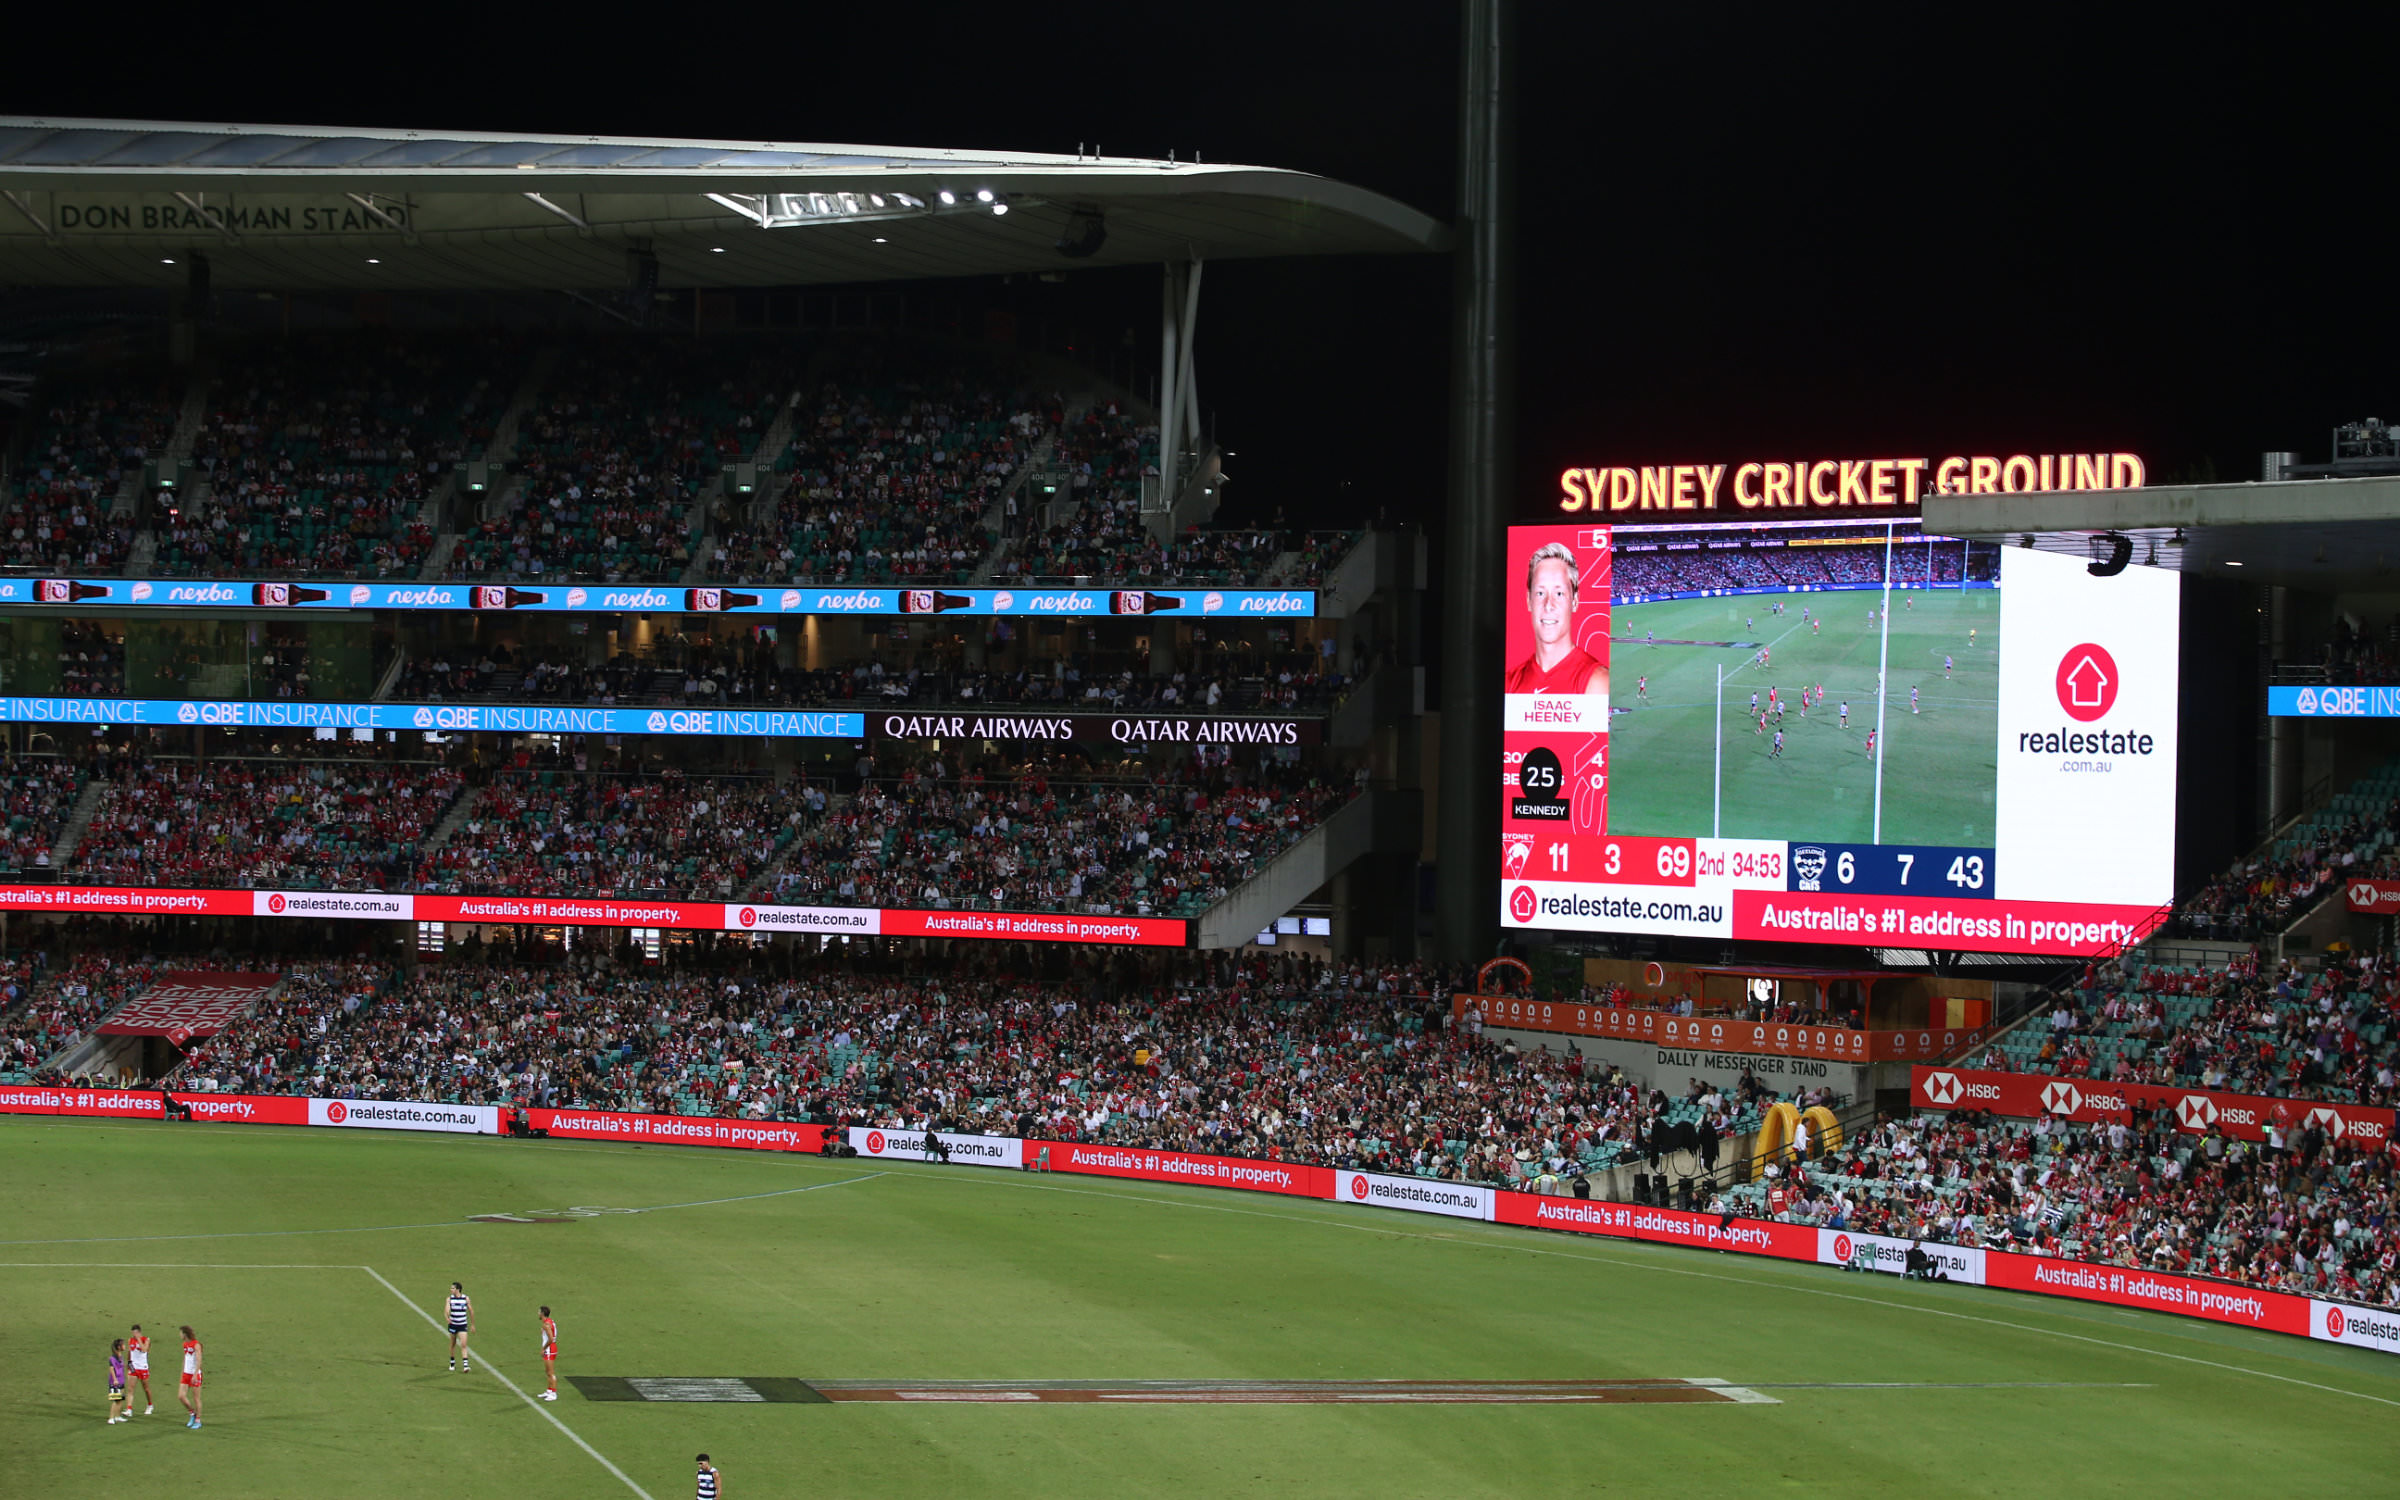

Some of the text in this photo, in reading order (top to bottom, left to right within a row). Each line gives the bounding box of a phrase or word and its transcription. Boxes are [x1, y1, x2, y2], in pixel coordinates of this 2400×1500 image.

[60, 204, 406, 232] DON BRADMAN STAND
[1560, 452, 2145, 512] SYDNEY CRICKET GROUND
[1592, 529, 1608, 549] 5
[12, 700, 147, 722] INSURANCE
[1534, 700, 1572, 711] ISAAC
[2321, 687, 2366, 715] QBE
[201, 703, 383, 727] QBE INSURANCE
[436, 708, 617, 731] QBE INSURANCE
[670, 711, 849, 736] QBE INSURANCE
[1524, 711, 1582, 723] HEENEY
[885, 716, 1073, 740] QATAR AIRWAYS
[1111, 719, 1297, 744] QATAR AIRWAYS
[2020, 727, 2153, 755] realestate
[1591, 752, 1604, 768] 4
[2059, 761, 2112, 773] .com.au
[1527, 766, 1555, 787] 25
[1590, 774, 1604, 789] 0
[1515, 804, 1566, 816] KENNEDY
[1502, 832, 1535, 840] SYDNEY
[1549, 843, 1569, 872] 11
[1604, 843, 1621, 875] 3
[1657, 845, 1690, 878] 69
[1698, 851, 1781, 879] 2nd 34:53
[1837, 851, 1855, 884] 6
[1897, 854, 1914, 886] 7
[1946, 855, 1984, 890] 43
[1799, 879, 1821, 892] CATS
[2380, 890, 2400, 902] HSB
[55, 891, 71, 904] #1
[73, 891, 128, 906] address
[131, 893, 143, 906] in
[146, 895, 208, 911] property.
[288, 896, 399, 914] realestate.com.au
[459, 901, 681, 923] Australia’s #1 address in property.
[1542, 893, 1723, 923] realestate.com.au
[758, 911, 868, 928] realestate.com.au
[925, 915, 1140, 939] Australia’s #1 address in property.
[1761, 903, 2140, 948] Australia's #1 address in property.
[125, 984, 195, 1028] SYDNEY
[154, 985, 224, 1028] SYDNEY
[183, 985, 253, 1029] SYDNEY
[1657, 1051, 1827, 1077] DALLY MESSENGER STAND
[77, 1094, 95, 1108] #1
[97, 1095, 161, 1110] address
[1967, 1083, 2000, 1100] HSBC
[2085, 1094, 2120, 1111] HSBC
[350, 1108, 476, 1126] realestate.com.au
[2221, 1107, 2255, 1125] HSBC
[552, 1114, 800, 1144] Australia’s #1 address in property.
[2348, 1120, 2384, 1138] HSBC
[887, 1137, 1003, 1158] realeste.com.au
[1071, 1149, 1292, 1188] Australia’s #1 address in property.
[1371, 1182, 1478, 1209] realestate.com.au
[1537, 1201, 1612, 1225] Australia’s
[1615, 1209, 1631, 1227] #1
[1634, 1212, 1690, 1234] address
[1692, 1218, 1706, 1237] in
[2034, 1263, 2265, 1320] Australia’s #1 address in property.
